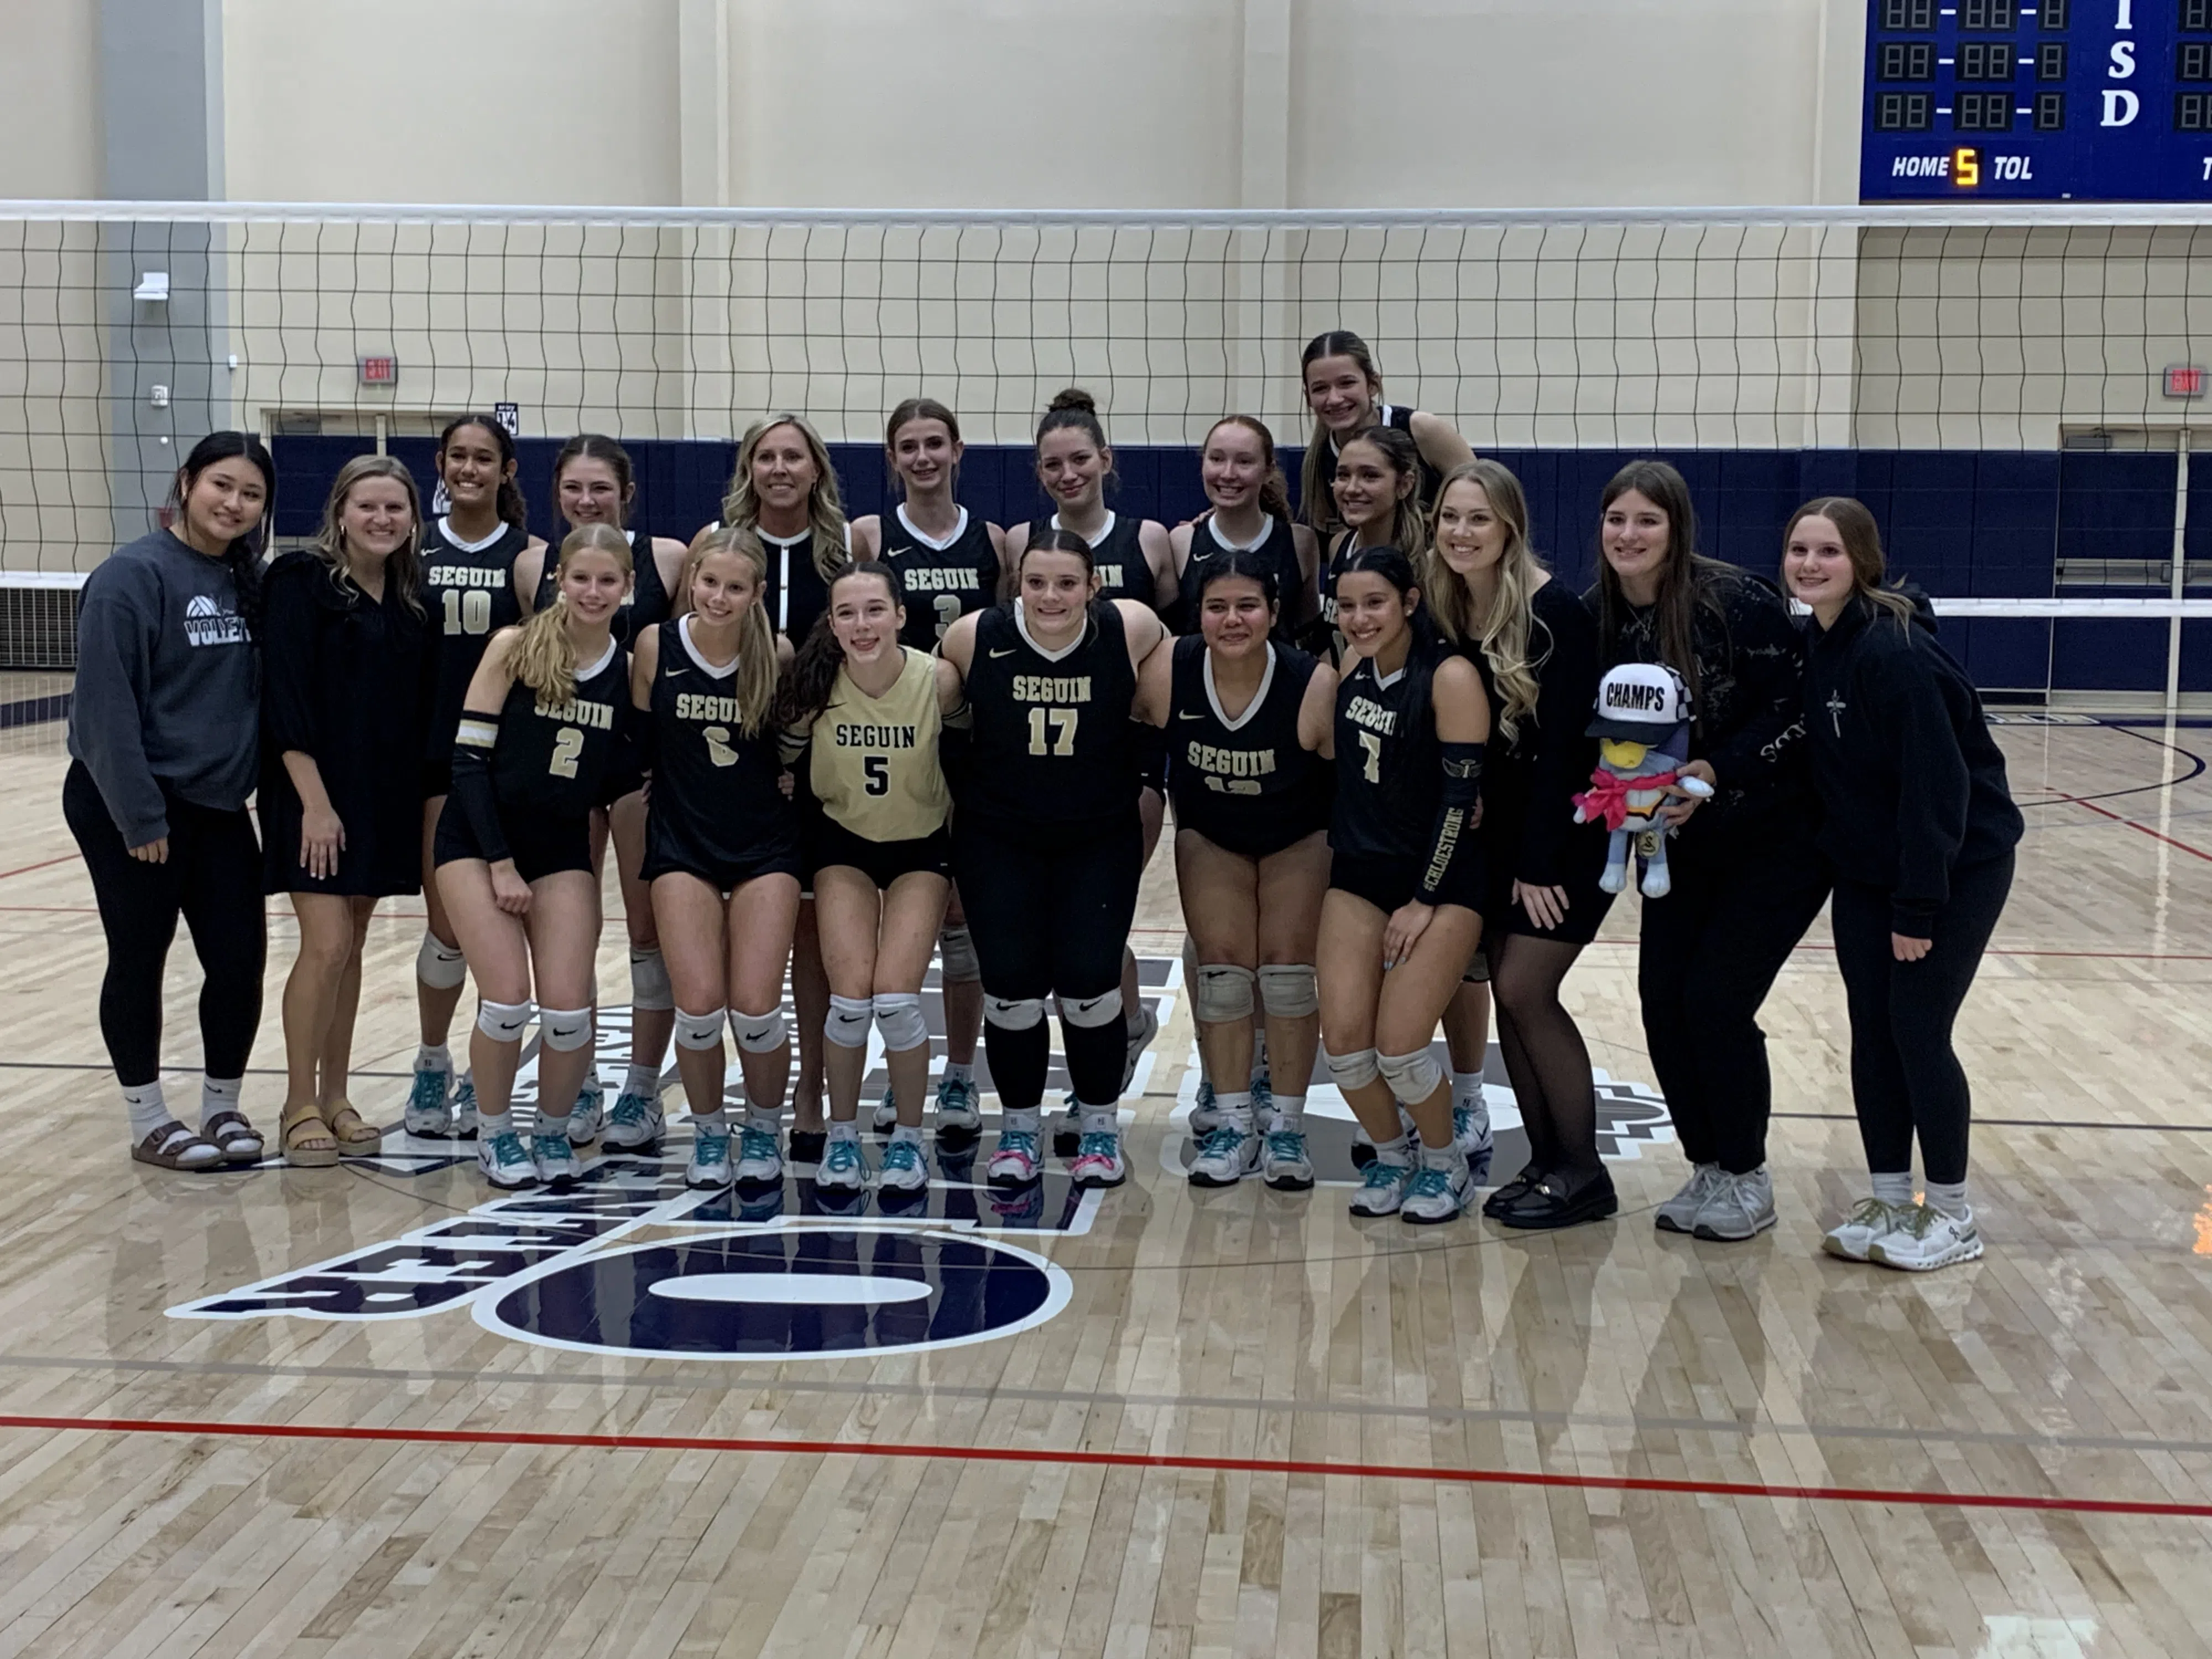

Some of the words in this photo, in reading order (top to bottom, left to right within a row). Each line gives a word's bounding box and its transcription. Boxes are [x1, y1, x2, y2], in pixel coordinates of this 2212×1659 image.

[1892, 156, 1950, 176] HOME
[1955, 148, 1979, 186] 5
[1994, 156, 2033, 180] TOL
[366, 358, 390, 380] EXIT
[428, 565, 506, 588] SEGUIN
[904, 568, 980, 591] SEGUIN
[442, 588, 492, 635] 10
[1013, 675, 1092, 703] SEGUIN
[1606, 682, 1665, 712] CHAMPS
[676, 693, 742, 724] SEGUI
[836, 723, 916, 749] SEGUIN
[1027, 707, 1078, 756] 17
[549, 727, 585, 779] 2
[1187, 740, 1276, 777] SEGUIN
[863, 754, 890, 798] 5
[1424, 806, 1464, 893] #CHLOESTRONG
